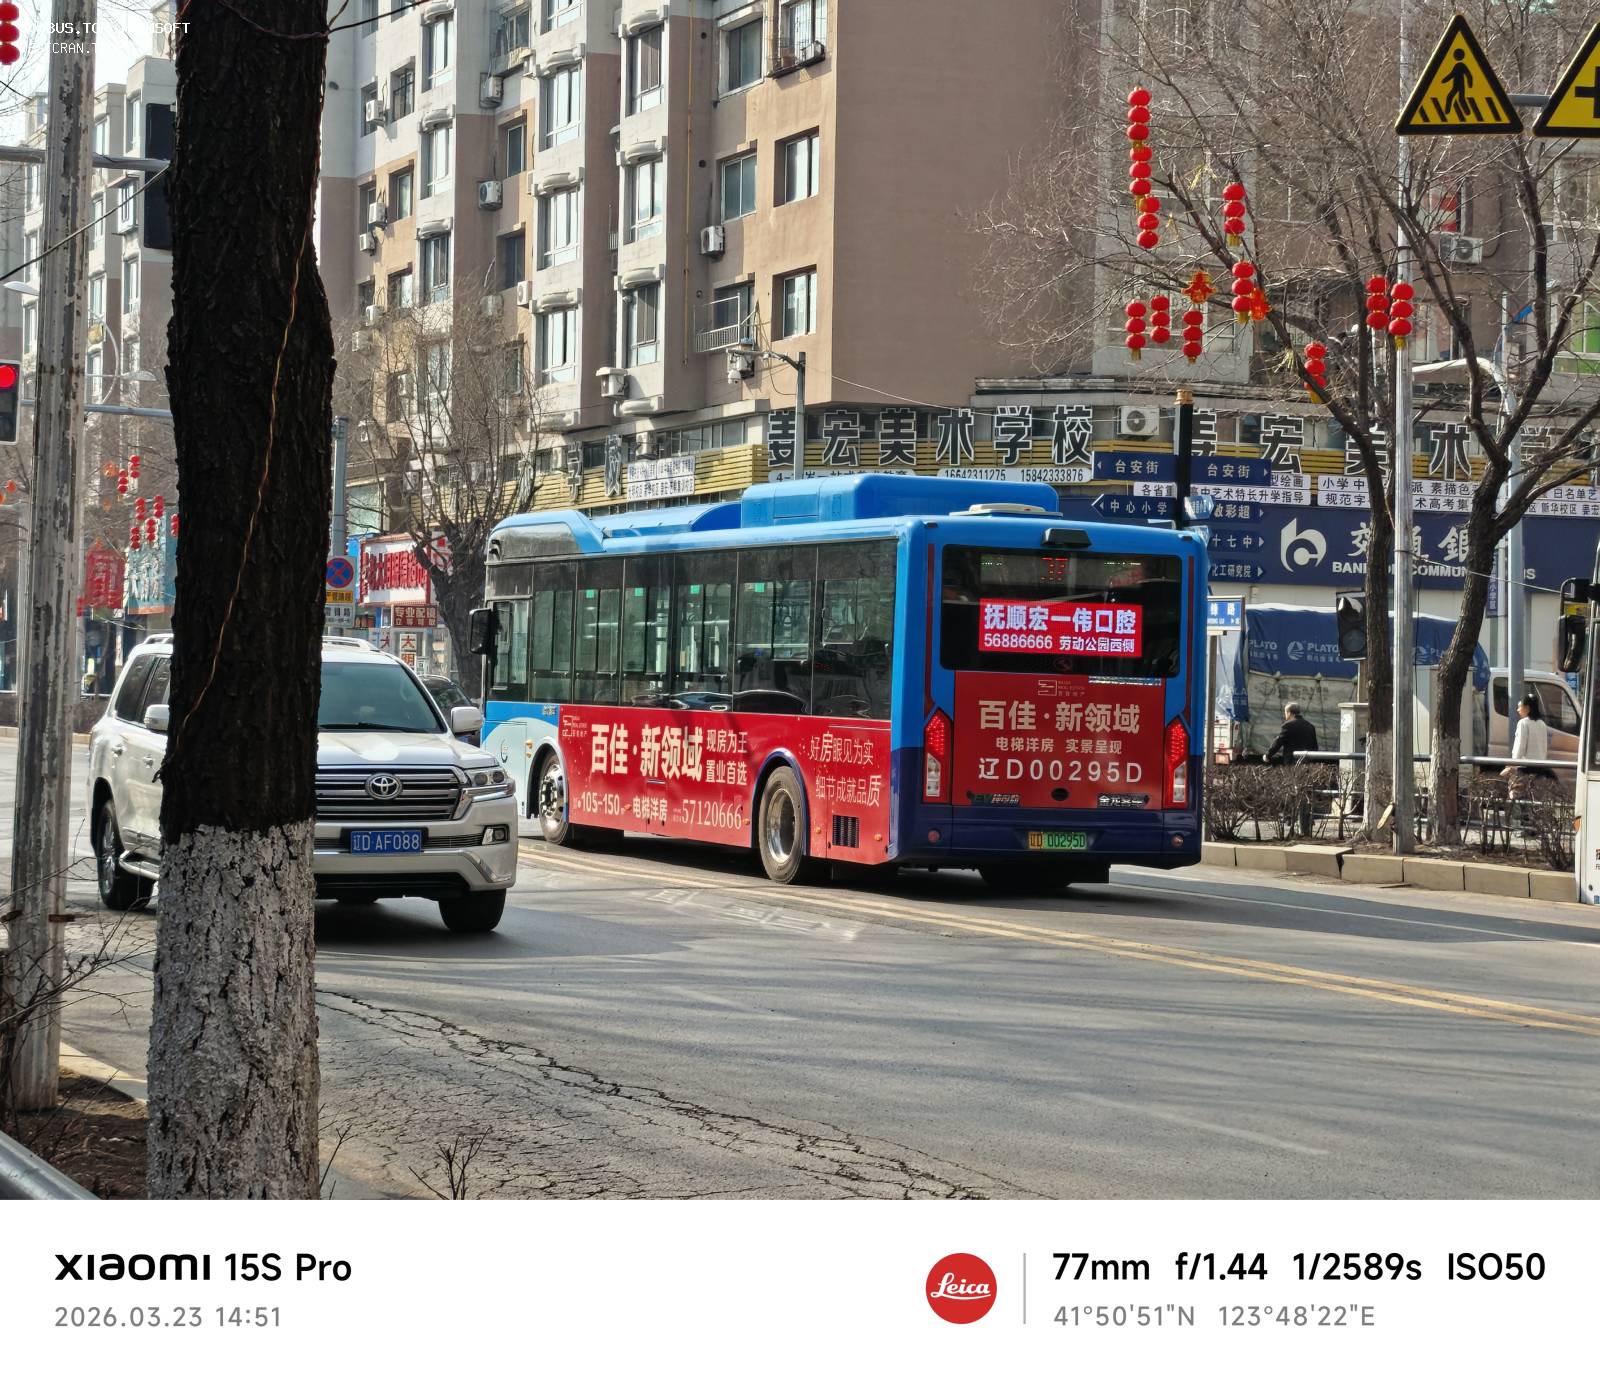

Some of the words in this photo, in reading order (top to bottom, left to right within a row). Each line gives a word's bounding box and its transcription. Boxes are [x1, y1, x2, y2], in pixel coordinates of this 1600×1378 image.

[768, 405, 1093, 467] 姜宏美术学校
[944, 469, 1006, 482] 16642311275
[1020, 468, 1084, 482] 15842333876
[1115, 460, 1159, 475] 台安街
[1207, 464, 1250, 478] 台安街
[1141, 483, 1304, 504] 各省重高中艺术特长升学指导
[1322, 478, 1366, 491] 小学中
[1110, 499, 1168, 516] 中心小学
[1324, 493, 1367, 506] 规范字
[984, 604, 1137, 634] 抚顺宏一伟口腔
[984, 633, 1053, 649] 56886666
[1059, 635, 1135, 653] 劳动公园西侧
[979, 700, 1141, 734] 百佳·新领域
[591, 723, 704, 782] 百佳·新领域
[706, 729, 748, 754] 现房为王
[809, 730, 874, 766] 好房眼见为实
[995, 736, 1054, 752] 电梯洋房
[1065, 739, 1123, 755] 实景呈现
[705, 759, 748, 786] 置业首选
[978, 758, 1142, 783] 辽D00295D
[815, 774, 882, 808] 细节成就品质
[632, 795, 669, 822] 电梯洋房
[681, 799, 743, 830] 57120666
